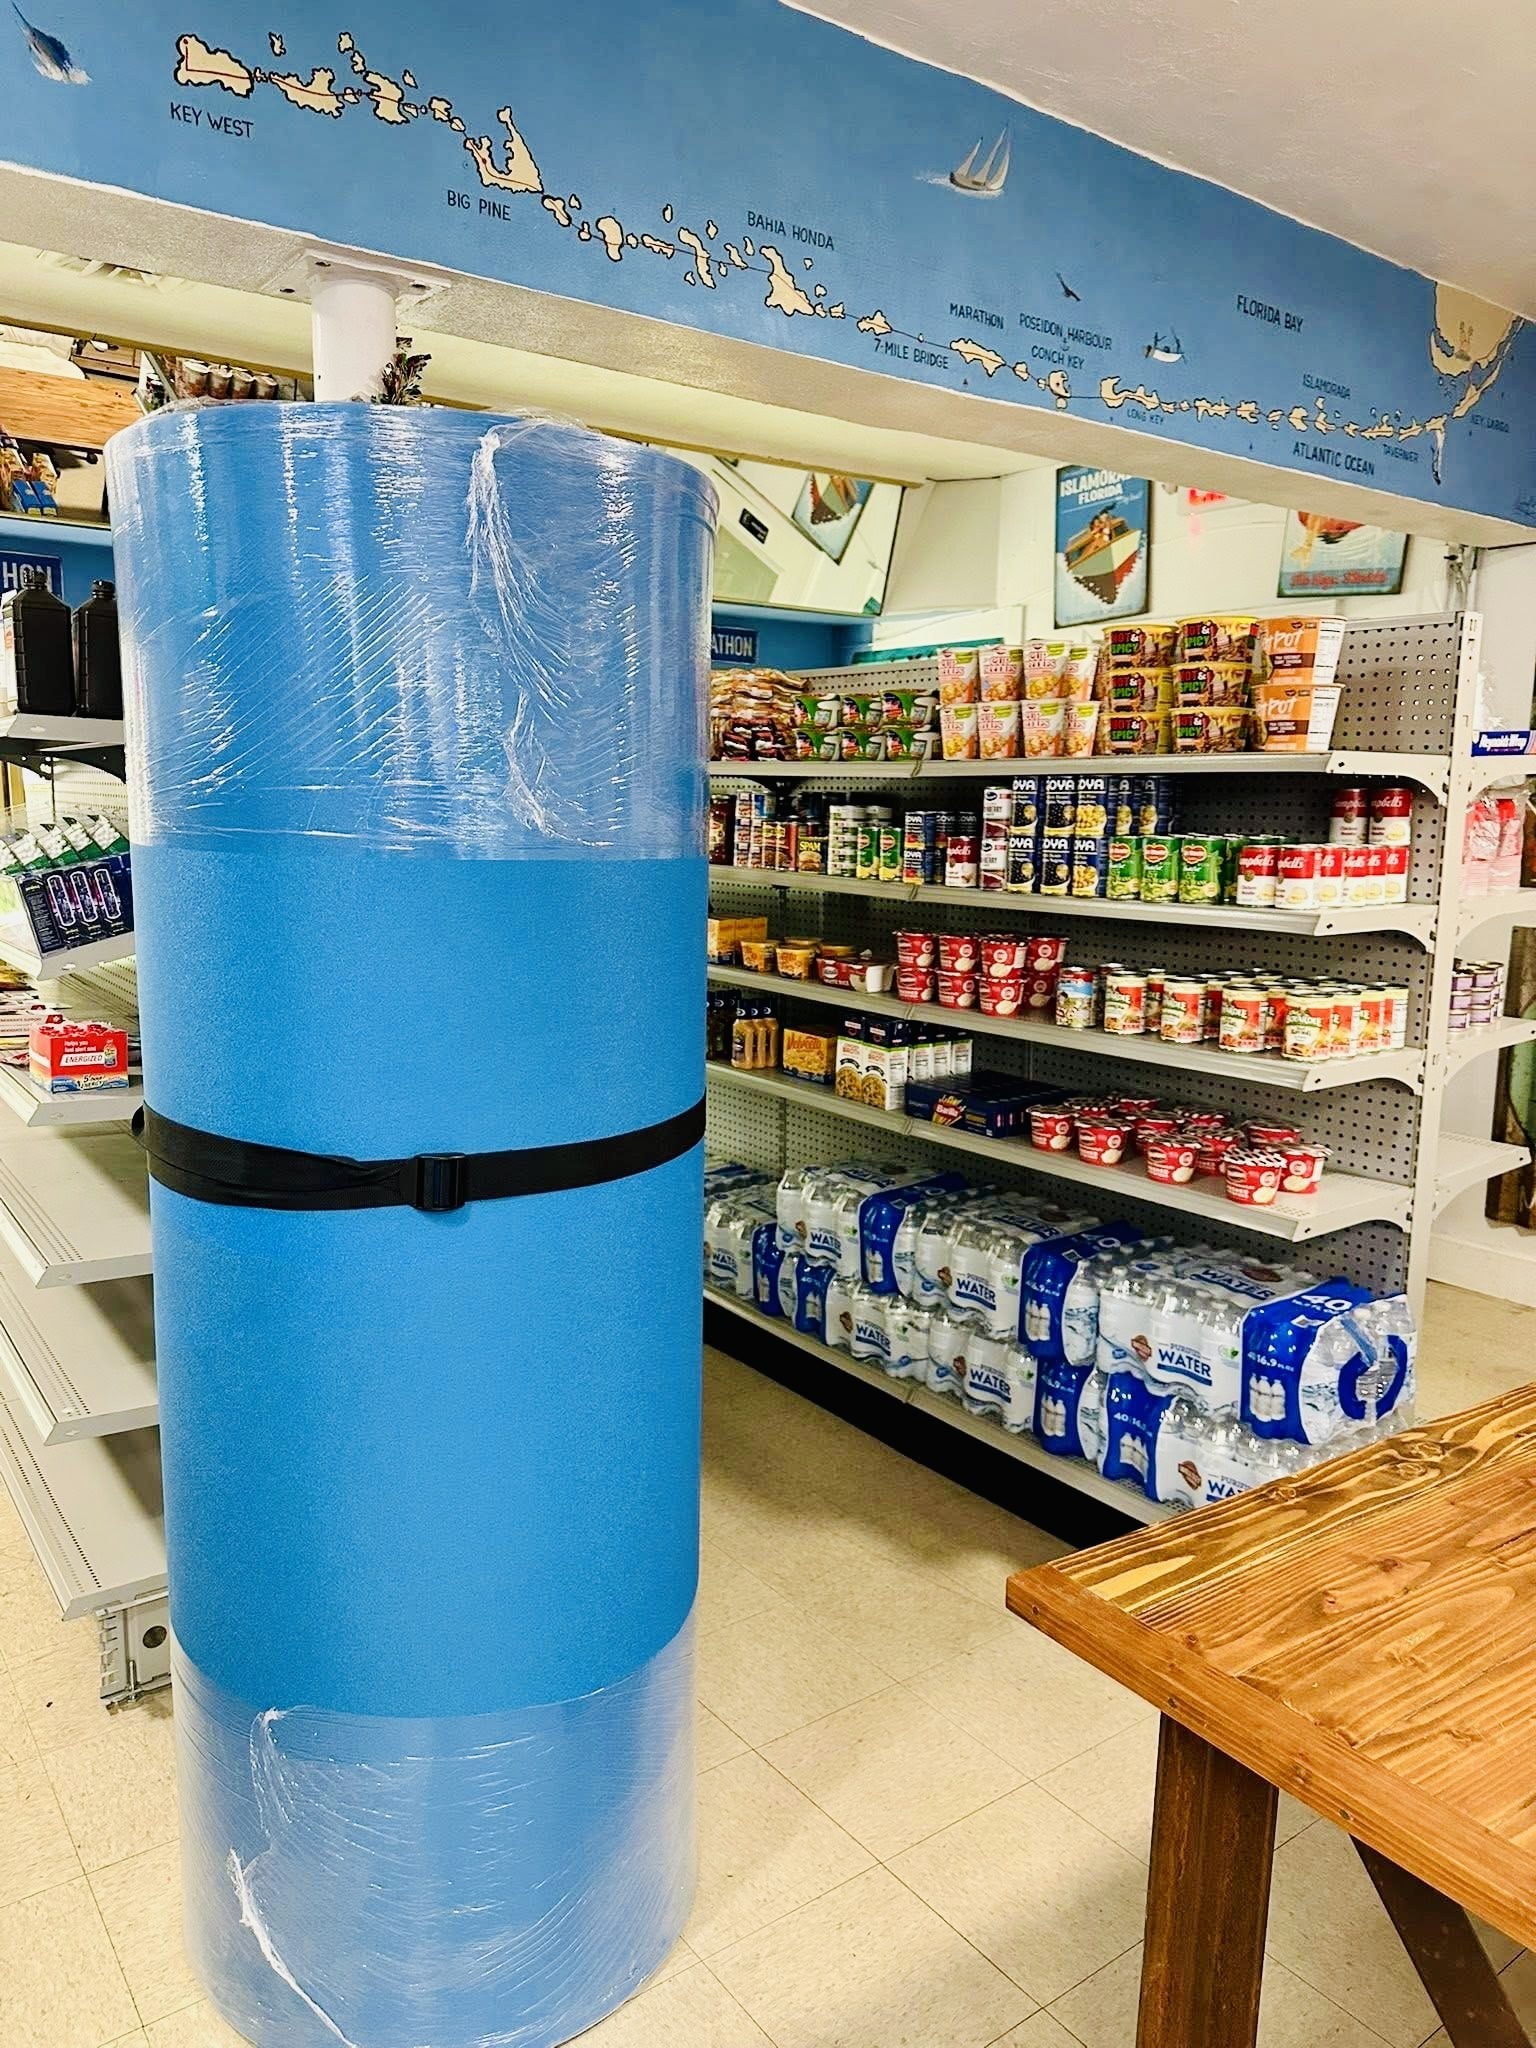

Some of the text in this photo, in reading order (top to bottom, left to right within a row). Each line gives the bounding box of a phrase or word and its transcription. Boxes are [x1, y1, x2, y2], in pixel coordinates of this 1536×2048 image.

[169, 101, 254, 138] KEY WEST
[447, 189, 511, 221] BIG PINE
[747, 210, 835, 251] BAHIA HONDA
[949, 302, 1005, 330] MARATHON
[1236, 294, 1304, 333] FLORIDA BAY
[1019, 312, 1112, 351] POSEIDON HARBOUR
[873, 338, 949, 371] 7-MILE BRIDGE
[1031, 345, 1085, 370] CONCH KEY
[1293, 440, 1375, 476] ATLANTIC OCEAN
[1078, 483, 1123, 505] FLORIDA
[799, 842, 821, 852] SPAM
[65, 1054, 103, 1064] ENERGIZED
[810, 1231, 842, 1249] WATER
[956, 1277, 997, 1304] WATER
[1301, 1295, 1353, 1311] 40
[856, 1323, 892, 1347] WATER
[1158, 1347, 1212, 1378] WATER
[1257, 1354, 1278, 1367] 16.9
[969, 1368, 1011, 1397] WATER
[1113, 1411, 1130, 1423] 40
[1207, 1479, 1242, 1498] WA
